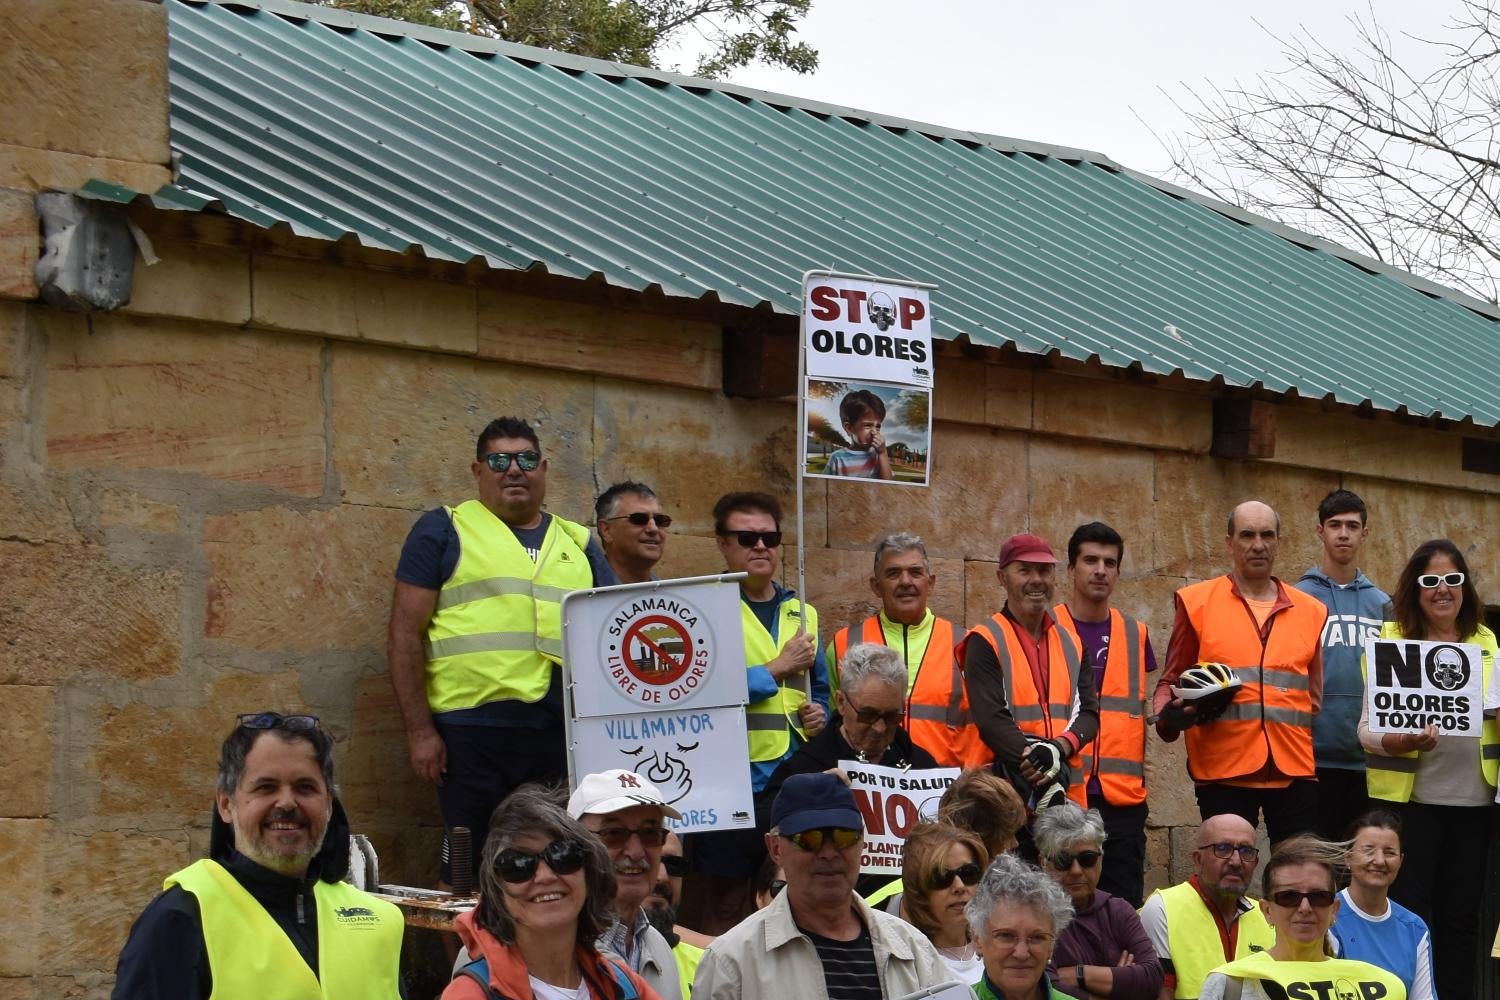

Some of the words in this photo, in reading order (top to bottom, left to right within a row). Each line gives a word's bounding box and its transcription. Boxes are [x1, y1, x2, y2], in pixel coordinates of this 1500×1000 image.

[811, 329, 927, 363] OLORES
[609, 598, 698, 637] SALAMANCA
[607, 655, 638, 695] LIBRE
[641, 689, 661, 704] DE
[668, 649, 709, 701] OLORES
[1374, 642, 1471, 692] NO
[1374, 692, 1470, 714] OLORES
[605, 713, 714, 740] VILLAMAYOR
[1376, 710, 1470, 732] TÓXICOS
[846, 770, 877, 786] POR
[878, 775, 896, 788] TU
[900, 777, 954, 791] SALUD
[667, 808, 718, 829] LORES
[851, 788, 920, 840] NO
